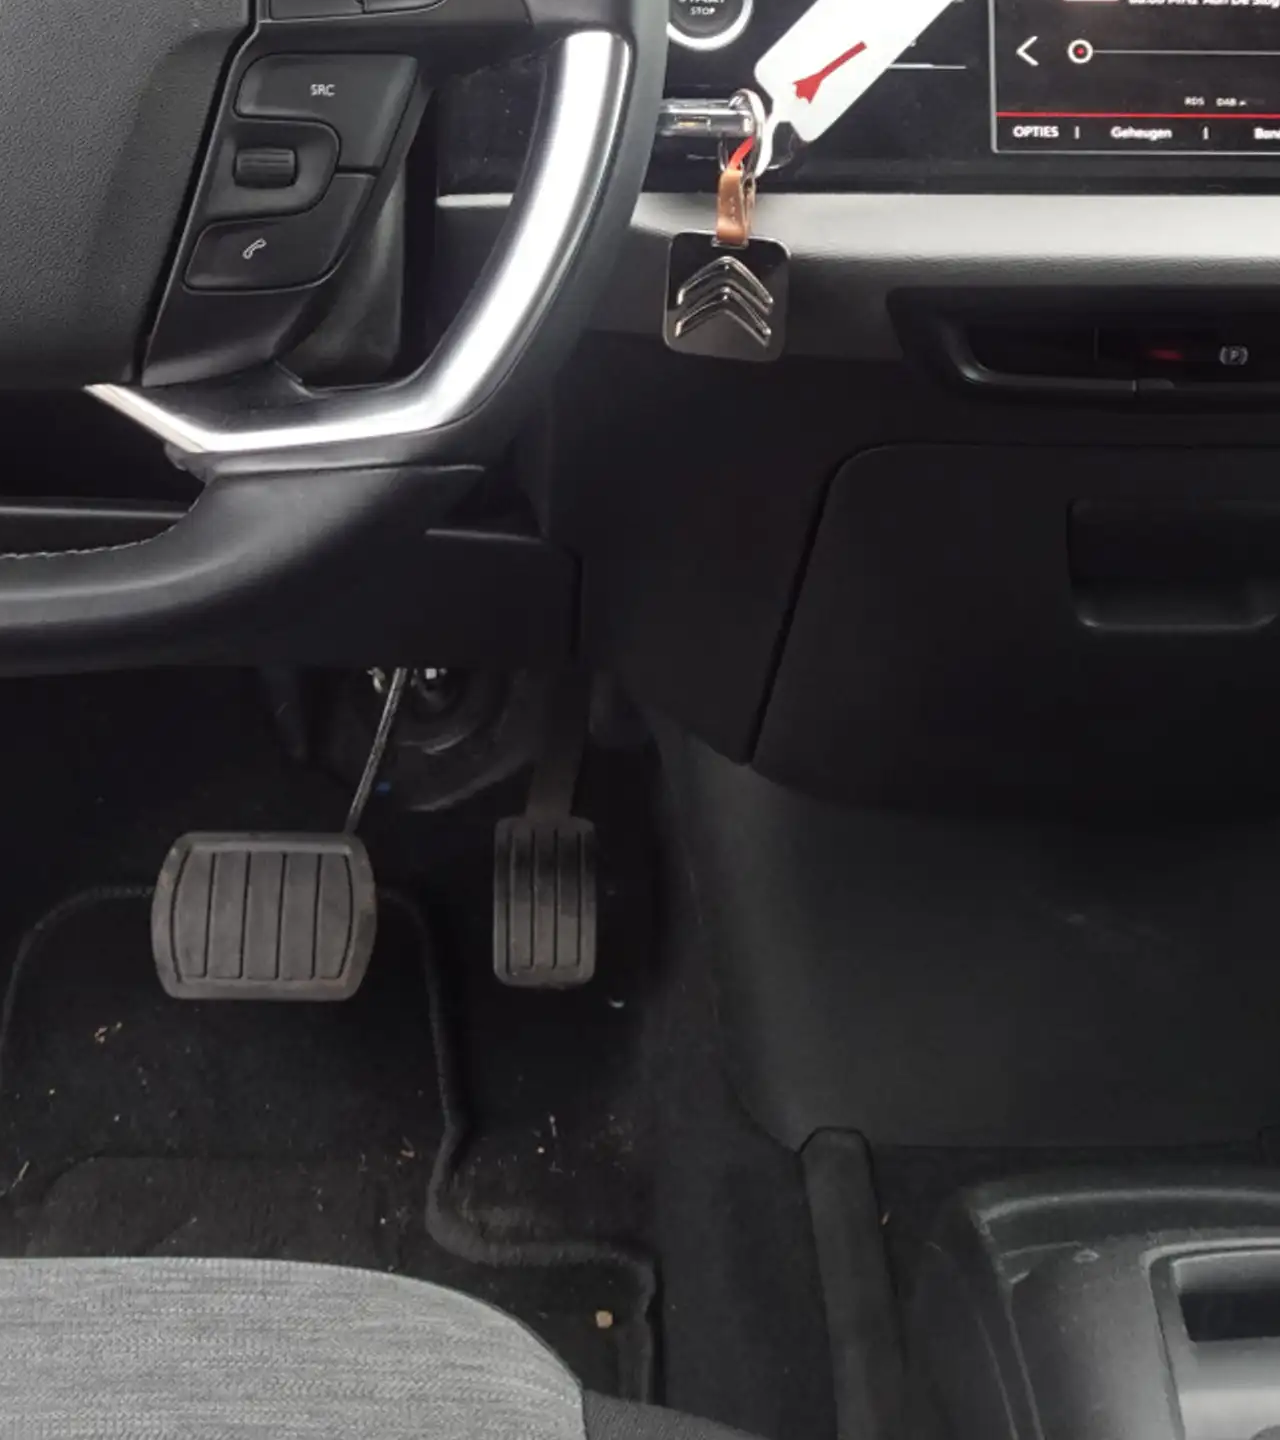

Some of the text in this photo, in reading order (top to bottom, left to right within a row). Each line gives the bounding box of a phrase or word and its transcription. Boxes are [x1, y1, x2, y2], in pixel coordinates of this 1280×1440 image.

[690, 5, 716, 16] STOP
[310, 83, 336, 97] SRC
[1012, 125, 1059, 139] OPTIES
